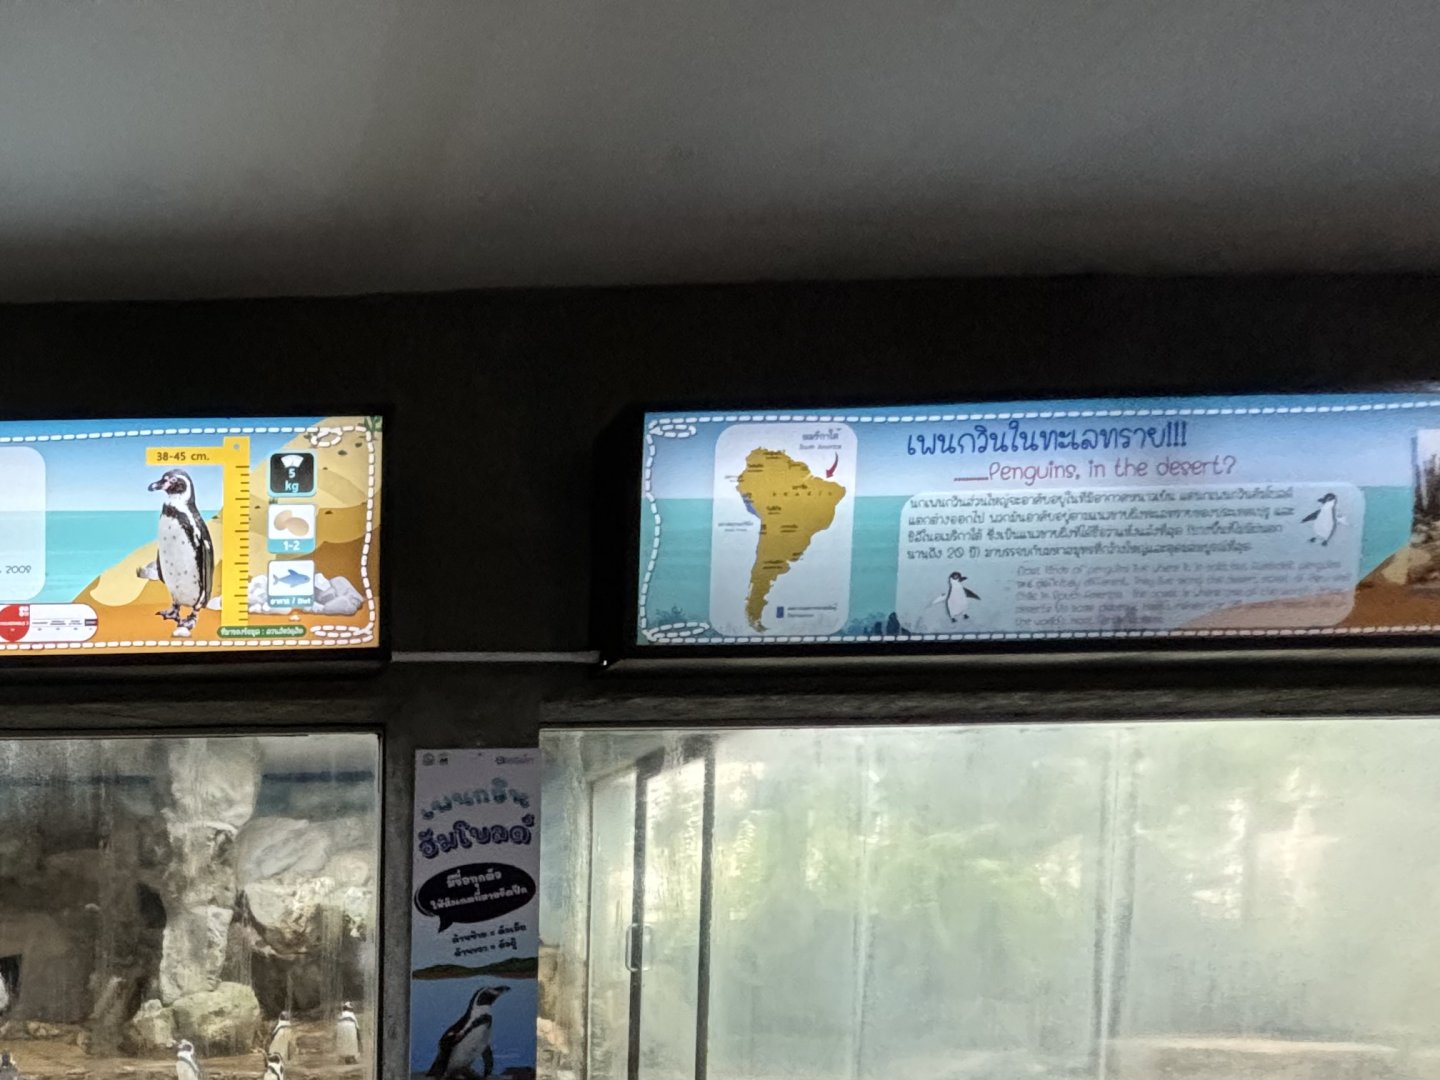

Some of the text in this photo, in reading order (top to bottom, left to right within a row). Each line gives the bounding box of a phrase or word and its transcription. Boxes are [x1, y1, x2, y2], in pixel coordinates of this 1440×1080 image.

[907, 420, 1188, 456] เพนกวินในทะเลทราย!!!
[156, 452, 211, 462] 38-45 cm.
[1088, 459, 1106, 478] in
[1114, 456, 1148, 476] the
[1156, 455, 1236, 476] desert?
[288, 468, 296, 479] 5
[284, 480, 300, 493] kg
[282, 540, 301, 551] 1-2
[947, 547, 964, 559] 20
[5, 564, 33, 575] zoos
